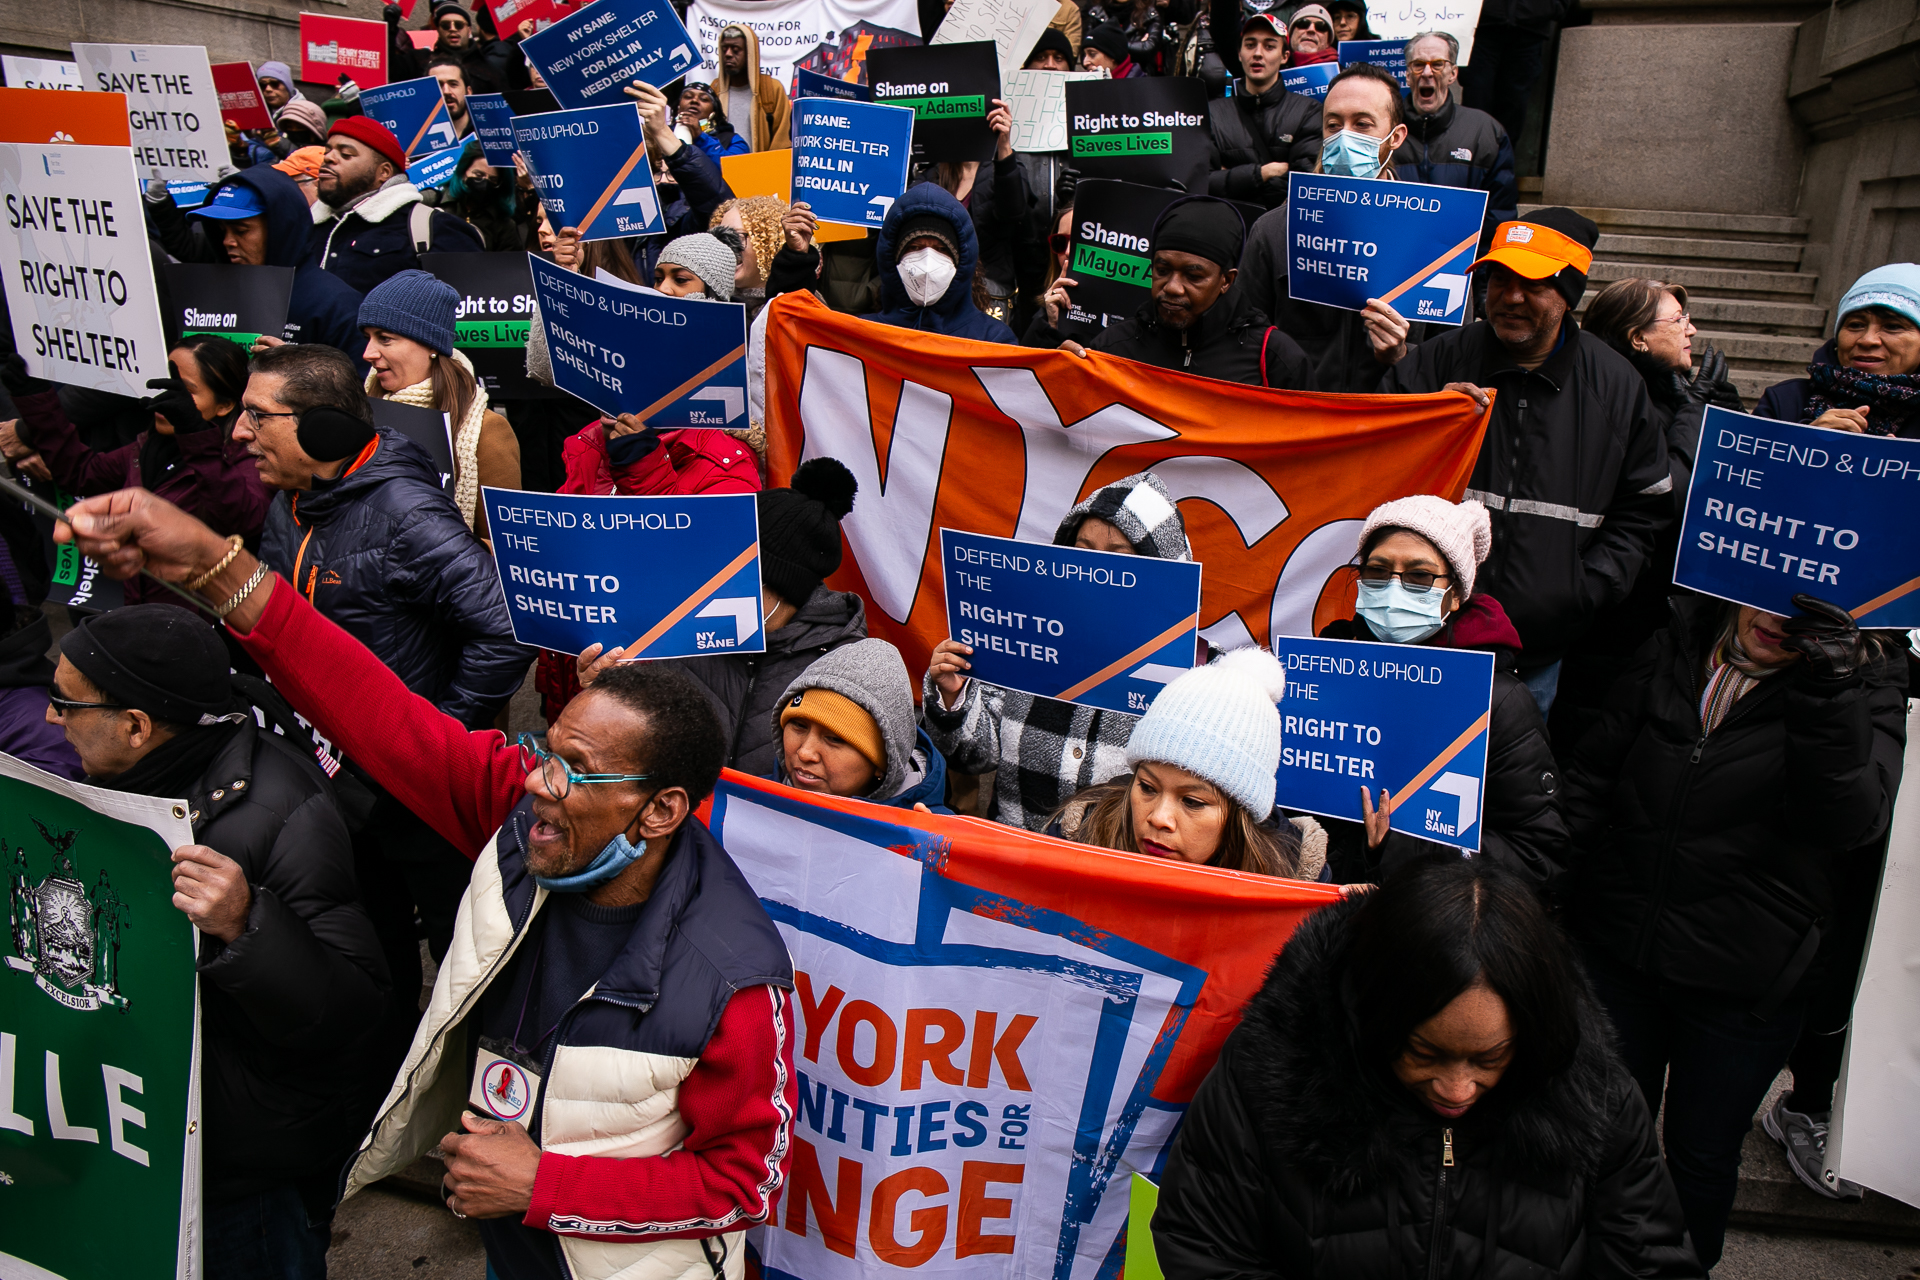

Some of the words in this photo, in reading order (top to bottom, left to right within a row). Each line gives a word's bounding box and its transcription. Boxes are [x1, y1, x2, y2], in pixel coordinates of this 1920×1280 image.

[566, 27, 584, 43] NY
[583, 11, 618, 35] SANE:
[700, 28, 792, 46] NEIHOOD
[795, 33, 819, 45] AND
[777, 21, 801, 31] FOR
[547, 54, 575, 76] NEW
[573, 38, 608, 62] YORK
[605, 9, 659, 46] SHELTER
[338, 55, 380, 70] SETTLEMENT
[581, 60, 608, 78] FOR
[606, 48, 629, 66] ALL
[628, 40, 643, 55] IN
[97, 72, 149, 93] SAVE
[151, 74, 193, 95] THE
[580, 76, 612, 99] NEED
[612, 47, 665, 84] EQUALLY
[384, 87, 417, 101] UPHOLD
[875, 81, 927, 97] Shame
[929, 82, 949, 94] on
[1293, 84, 1329, 97] HELTE
[925, 97, 983, 115] Adams!
[129, 110, 168, 131] GHT
[171, 112, 200, 132] TO
[479, 127, 499, 137] RIGHT
[500, 127, 512, 136] TO
[515, 127, 541, 142] DEFEND
[541, 126, 548, 139] &
[548, 121, 599, 139] UPHOLD
[803, 114, 815, 125] NY
[814, 114, 851, 129] SANE:
[1074, 113, 1119, 134] Right
[1121, 113, 1140, 129] to
[1142, 111, 1204, 128] Shelter
[483, 141, 514, 150] SHELTER
[823, 137, 890, 158] SHELTER
[1075, 138, 1123, 152] Saves
[1126, 135, 1169, 151] Lives
[421, 164, 433, 175] NY
[798, 155, 810, 168] FOR
[810, 156, 836, 171] ALL
[837, 158, 854, 173] IN
[424, 172, 447, 186] YORK
[548, 174, 564, 189] TO
[804, 176, 870, 196] EQUALLY
[1297, 185, 1358, 204] DEFEND
[1360, 192, 1371, 206] &
[1375, 193, 1441, 213] UPHOLD
[6, 193, 67, 233] SAVE
[67, 198, 118, 238] THE
[616, 216, 629, 225] NY
[1297, 207, 1325, 223] THE
[618, 223, 645, 232] SANE
[1080, 221, 1150, 253] Shame
[1296, 233, 1348, 254] RIGHT
[1352, 240, 1378, 257] TO
[1077, 247, 1140, 278] Mayor
[1296, 257, 1369, 282] SHELTER
[19, 259, 89, 301] RIGHT
[92, 268, 128, 306] TO
[455, 295, 486, 319] ght
[489, 297, 509, 314] to
[539, 271, 595, 306] DEFEND
[598, 296, 609, 311] &
[611, 300, 687, 327] UPHOLD
[543, 293, 570, 318] THE
[1418, 299, 1433, 308] NY
[184, 307, 221, 327] Shame
[222, 312, 237, 328] on
[1069, 314, 1092, 324] SOCIETY
[1070, 310, 1087, 318] LEGAL
[1417, 307, 1444, 317] SANE
[494, 324, 530, 342] Live
[31, 323, 140, 374] SHELTER!
[550, 321, 597, 357] RIGHT
[600, 346, 626, 369] TO
[555, 346, 624, 394] SHELTER
[1717, 429, 1829, 468] DEFEND
[1835, 453, 1853, 474] &
[1862, 457, 1920, 481] UPH
[1713, 460, 1764, 489] THE
[498, 505, 576, 529] DEFEND
[582, 513, 596, 530] &
[600, 513, 692, 530] UPHOLD
[1704, 497, 1805, 539] RIGHT
[1813, 523, 1859, 550] TO
[501, 532, 540, 552] THE
[954, 545, 1031, 573] DEFEND
[1035, 559, 1048, 576] &
[1052, 561, 1137, 588] UPHOLD
[1697, 531, 1841, 585] SHELTER
[509, 564, 578, 591] RIGHT
[583, 575, 620, 594] TO
[955, 570, 992, 592] THE
[515, 594, 617, 624] SHELTER
[959, 600, 1027, 629] RIGHT
[1032, 615, 1064, 637] TO
[696, 631, 716, 641] NY
[696, 639, 735, 650] SANE
[960, 628, 1059, 665] SHELTER
[1287, 653, 1355, 675] DEFEND
[1358, 659, 1369, 677] &
[1373, 661, 1442, 685] UPHOLD
[1128, 691, 1146, 701] NY
[1286, 681, 1319, 701] THE
[1128, 699, 1152, 711] SAN
[1285, 715, 1348, 741] RIGHT
[1353, 724, 1382, 746] TO
[1282, 747, 1375, 780] SHELTER
[1426, 808, 1442, 822] NY
[1425, 819, 1456, 837] SANE
[44, 981, 91, 1009] EXCELSIOR
[794, 969, 1039, 1092] YORK
[796, 1070, 990, 1156] NITIES
[998, 1103, 1031, 1150] FOR
[768, 1135, 1025, 1269] NGE
